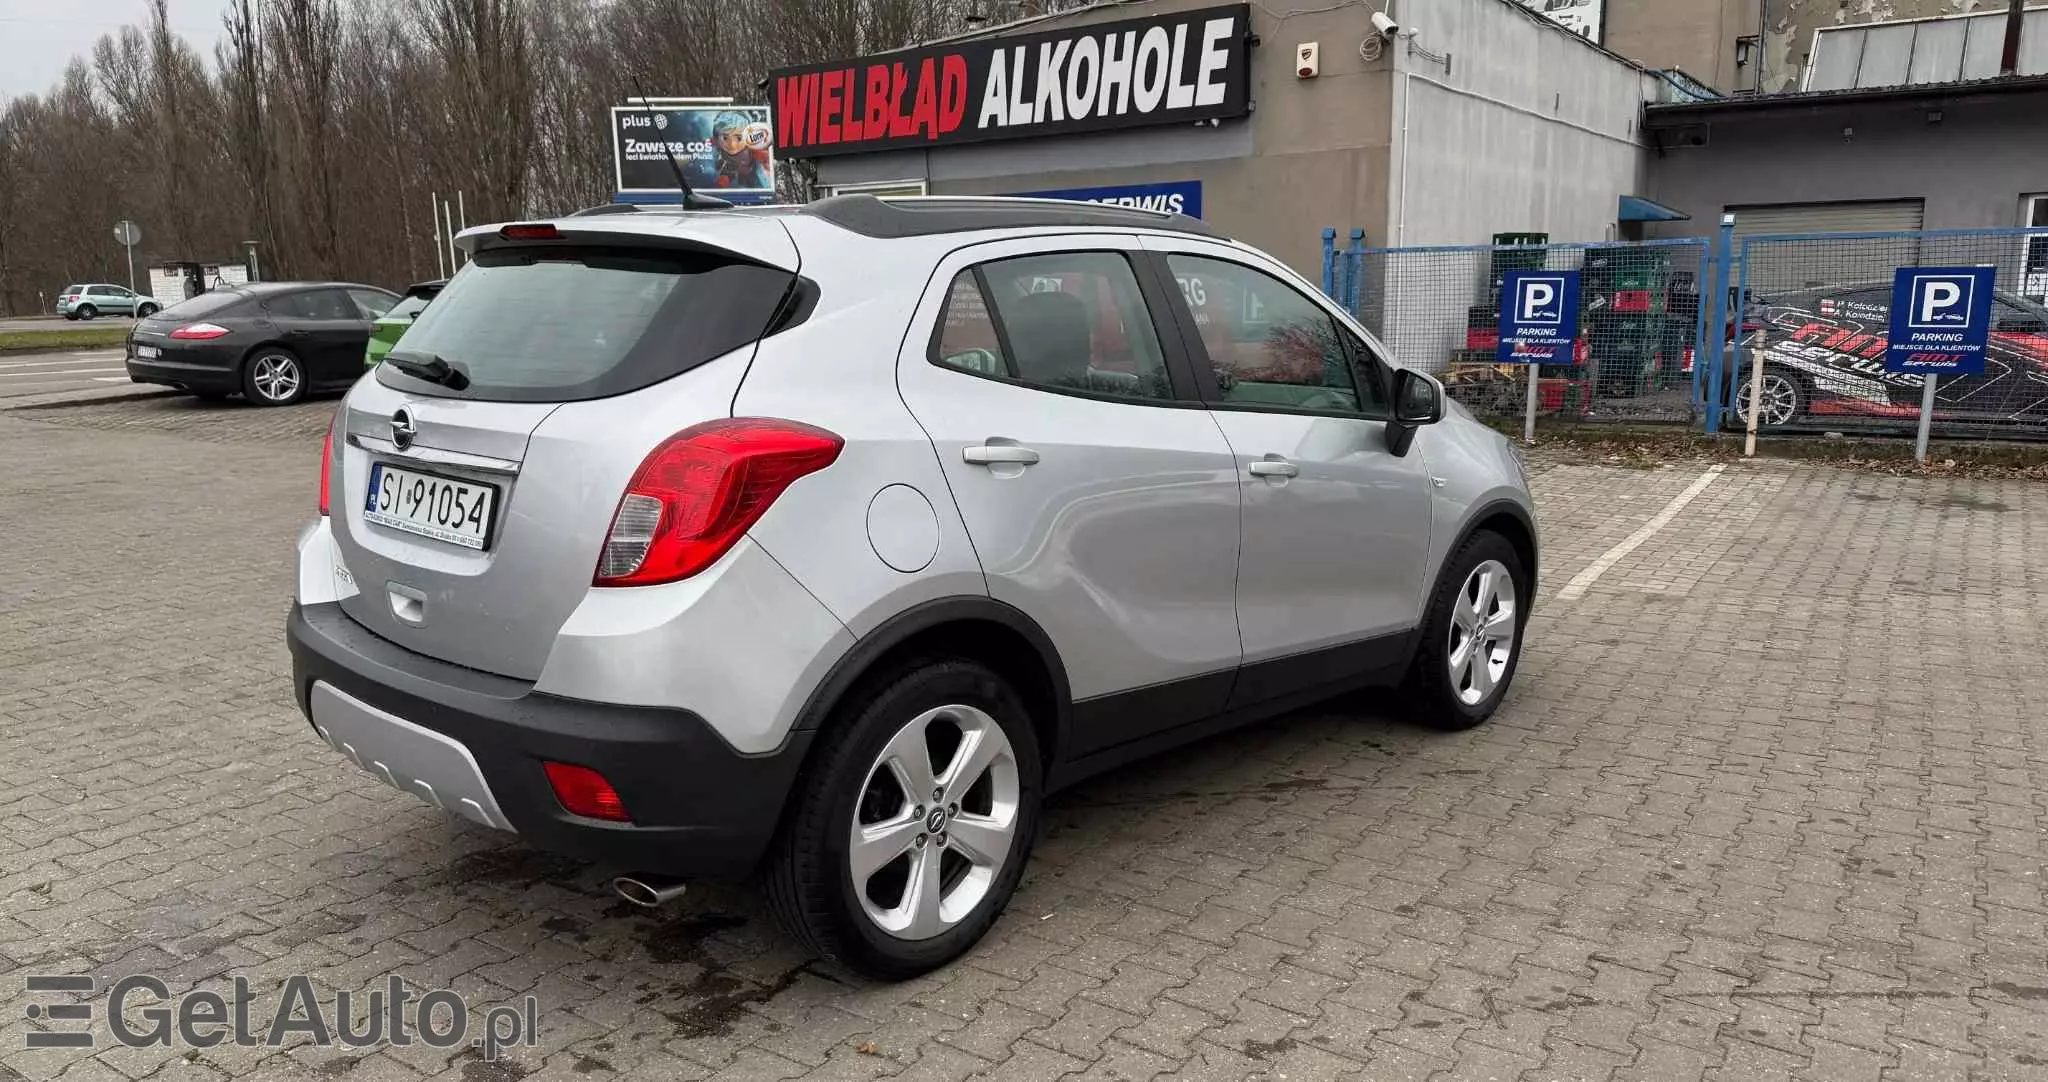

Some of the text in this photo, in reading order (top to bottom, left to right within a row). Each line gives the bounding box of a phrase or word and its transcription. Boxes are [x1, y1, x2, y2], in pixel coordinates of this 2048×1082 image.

[777, 17, 1234, 148] WIELBŁĄD ALKOHOLE
[622, 114, 650, 129] plus
[624, 139, 713, 152] Zawsze coś
[1087, 193, 1184, 214] WIS
[1524, 284, 1553, 318] P
[1921, 282, 1960, 321] P
[1516, 327, 1557, 336] PARKING
[1911, 333, 1964, 342] PARKING
[1892, 343, 1923, 351] MIEJSCE
[381, 472, 404, 514] SI
[410, 479, 485, 534] 91054
